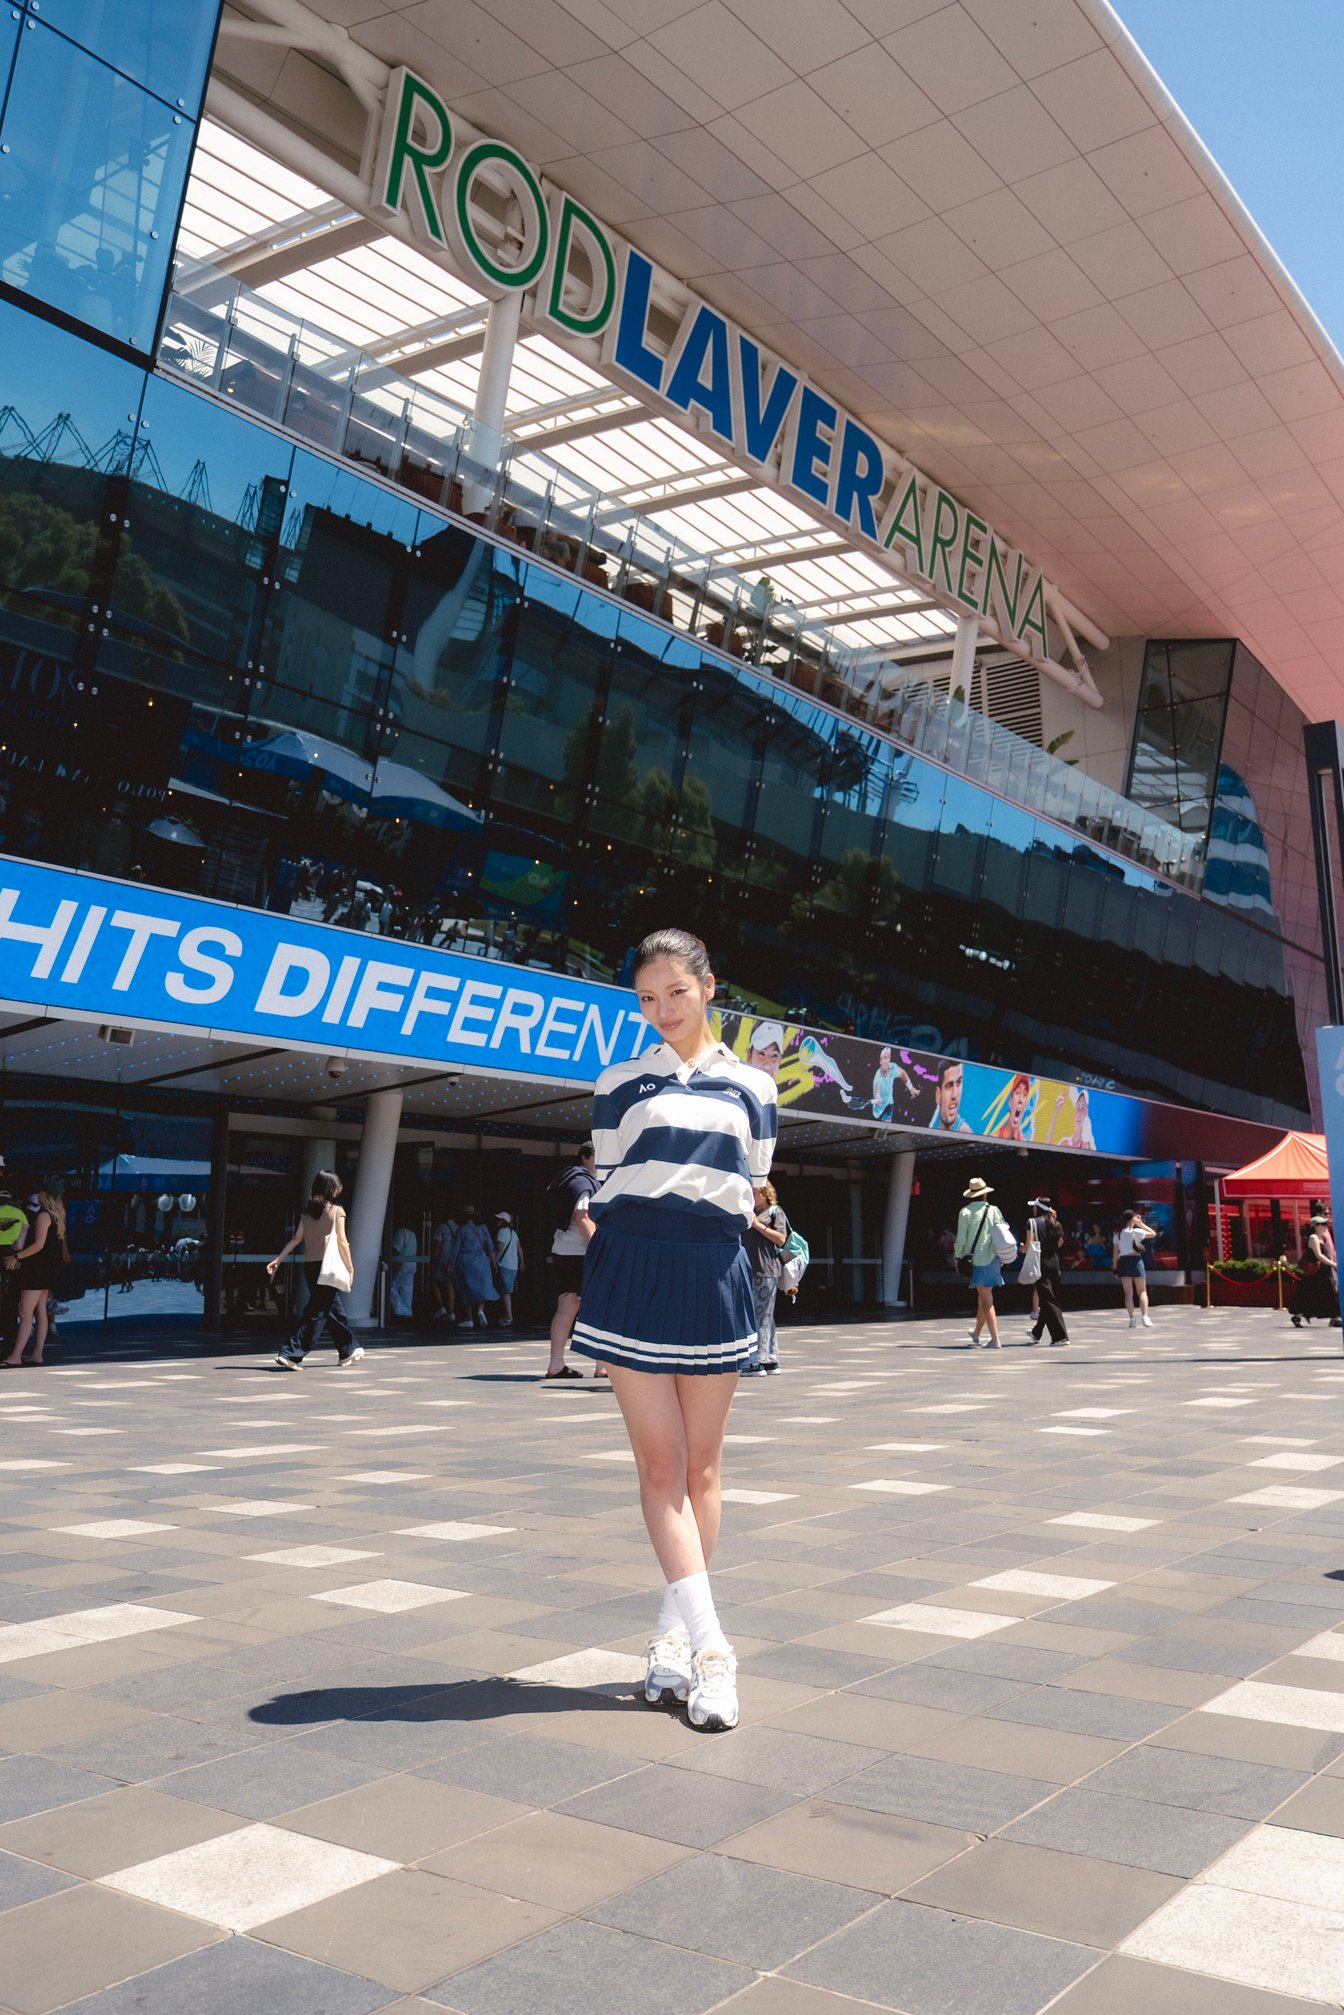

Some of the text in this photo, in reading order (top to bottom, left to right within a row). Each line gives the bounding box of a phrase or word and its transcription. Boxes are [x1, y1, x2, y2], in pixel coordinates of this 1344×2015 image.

[378, 66, 1049, 660] ROD LAVER ARENA
[0, 888, 652, 1066] HITS DIFFERENT
[639, 1082, 656, 1095] AO
